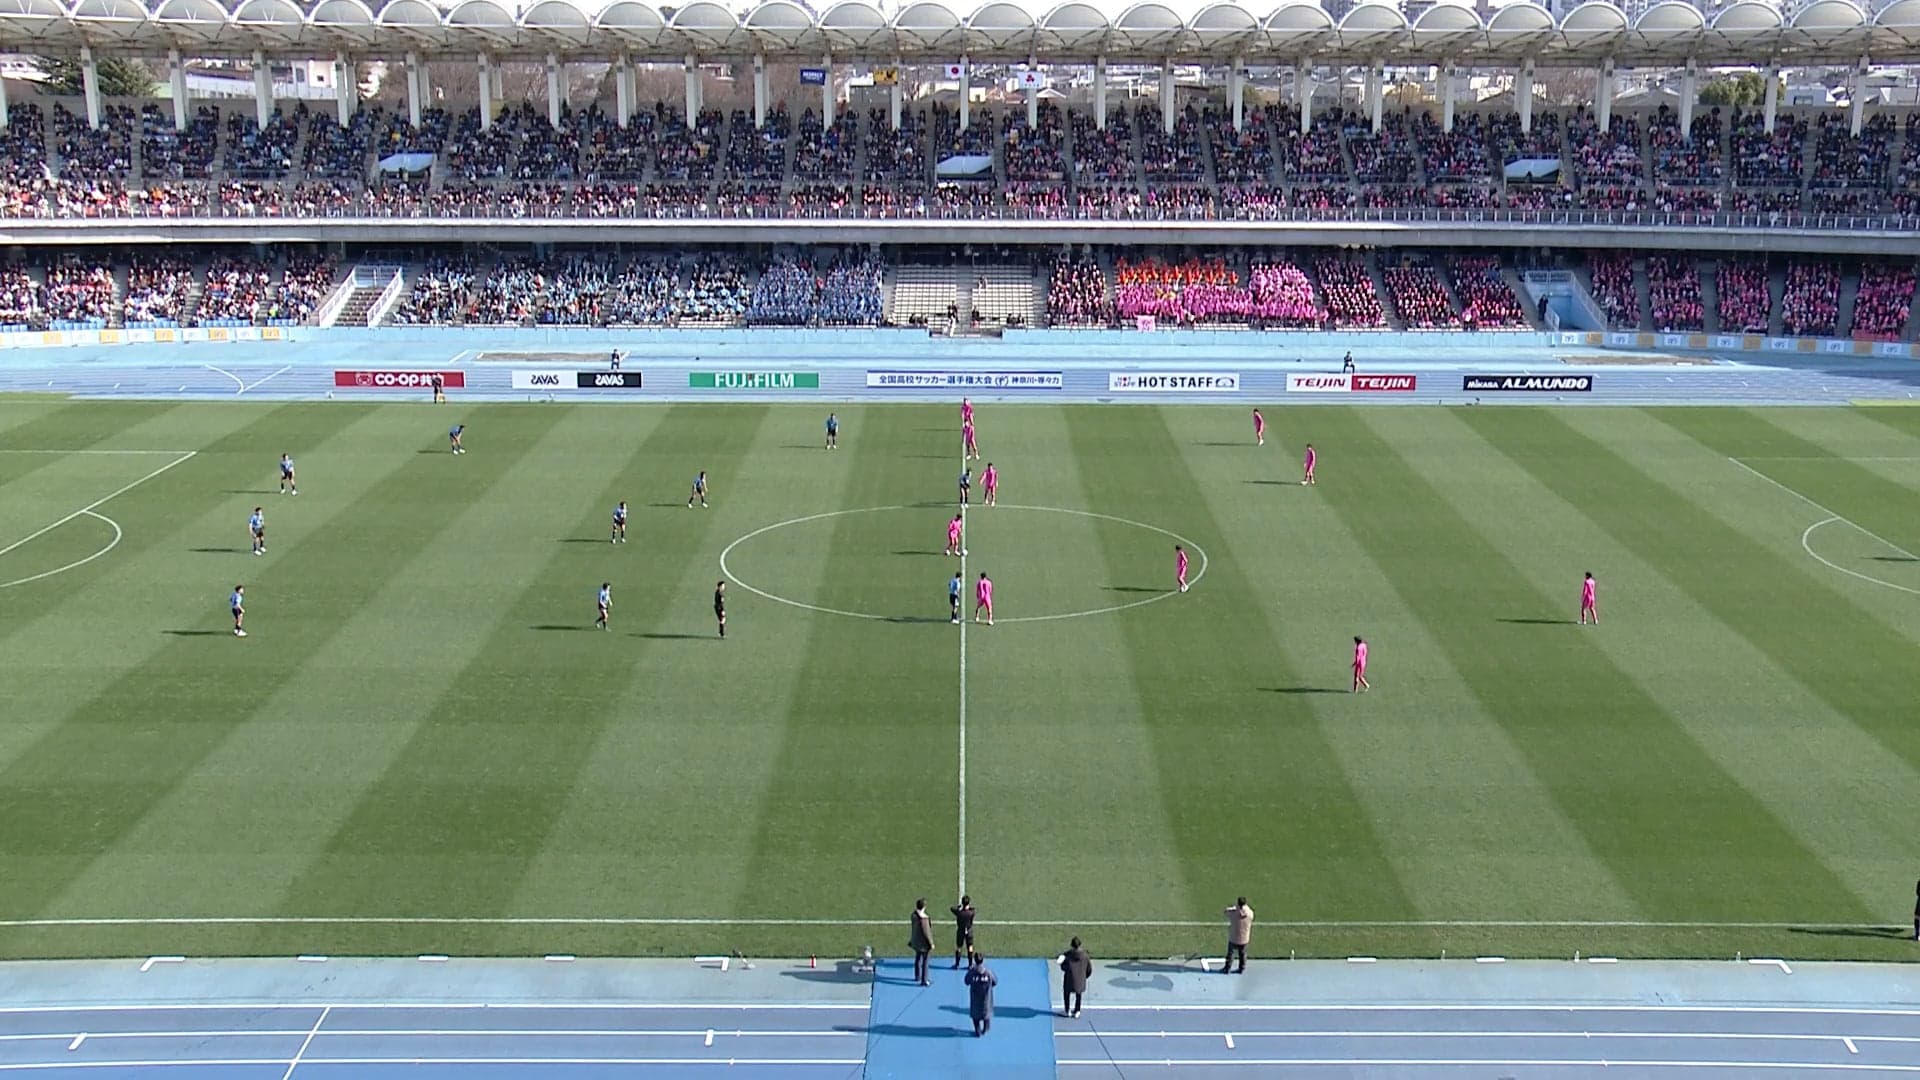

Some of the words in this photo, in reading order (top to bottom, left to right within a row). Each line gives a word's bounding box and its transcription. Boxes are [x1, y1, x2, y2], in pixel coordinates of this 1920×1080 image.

[715, 373, 794, 387] FUJIFILM
[1138, 376, 1167, 388] HOT
[1170, 376, 1214, 388] STAFF
[1294, 377, 1346, 388] TEIJIN
[1357, 377, 1411, 389] TEIJIN
[1502, 377, 1589, 389] ALMUNDO
